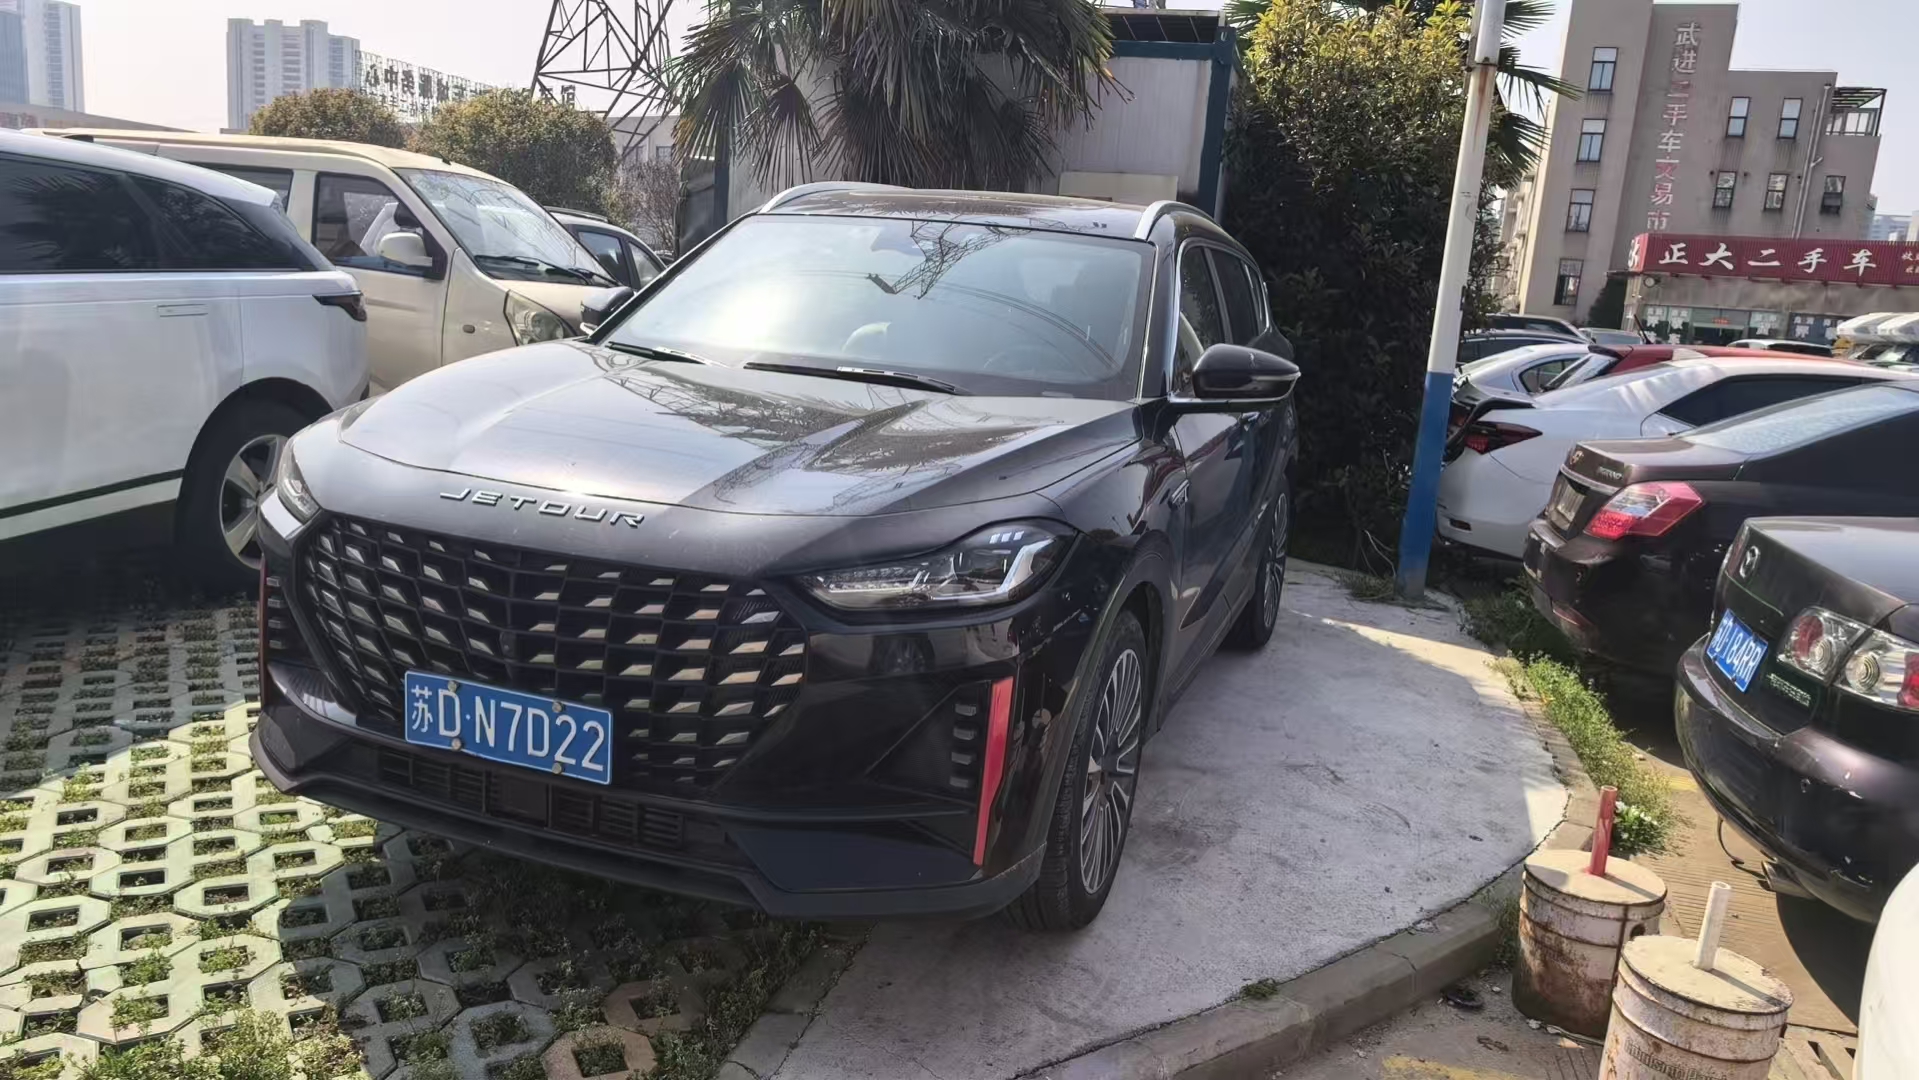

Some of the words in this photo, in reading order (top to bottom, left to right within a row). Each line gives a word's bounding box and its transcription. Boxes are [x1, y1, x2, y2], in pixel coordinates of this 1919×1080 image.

[1646, 22, 1702, 231] 武进二手车交易市
[1658, 242, 1877, 277] 正大二手车
[439, 487, 646, 528] JETOUR
